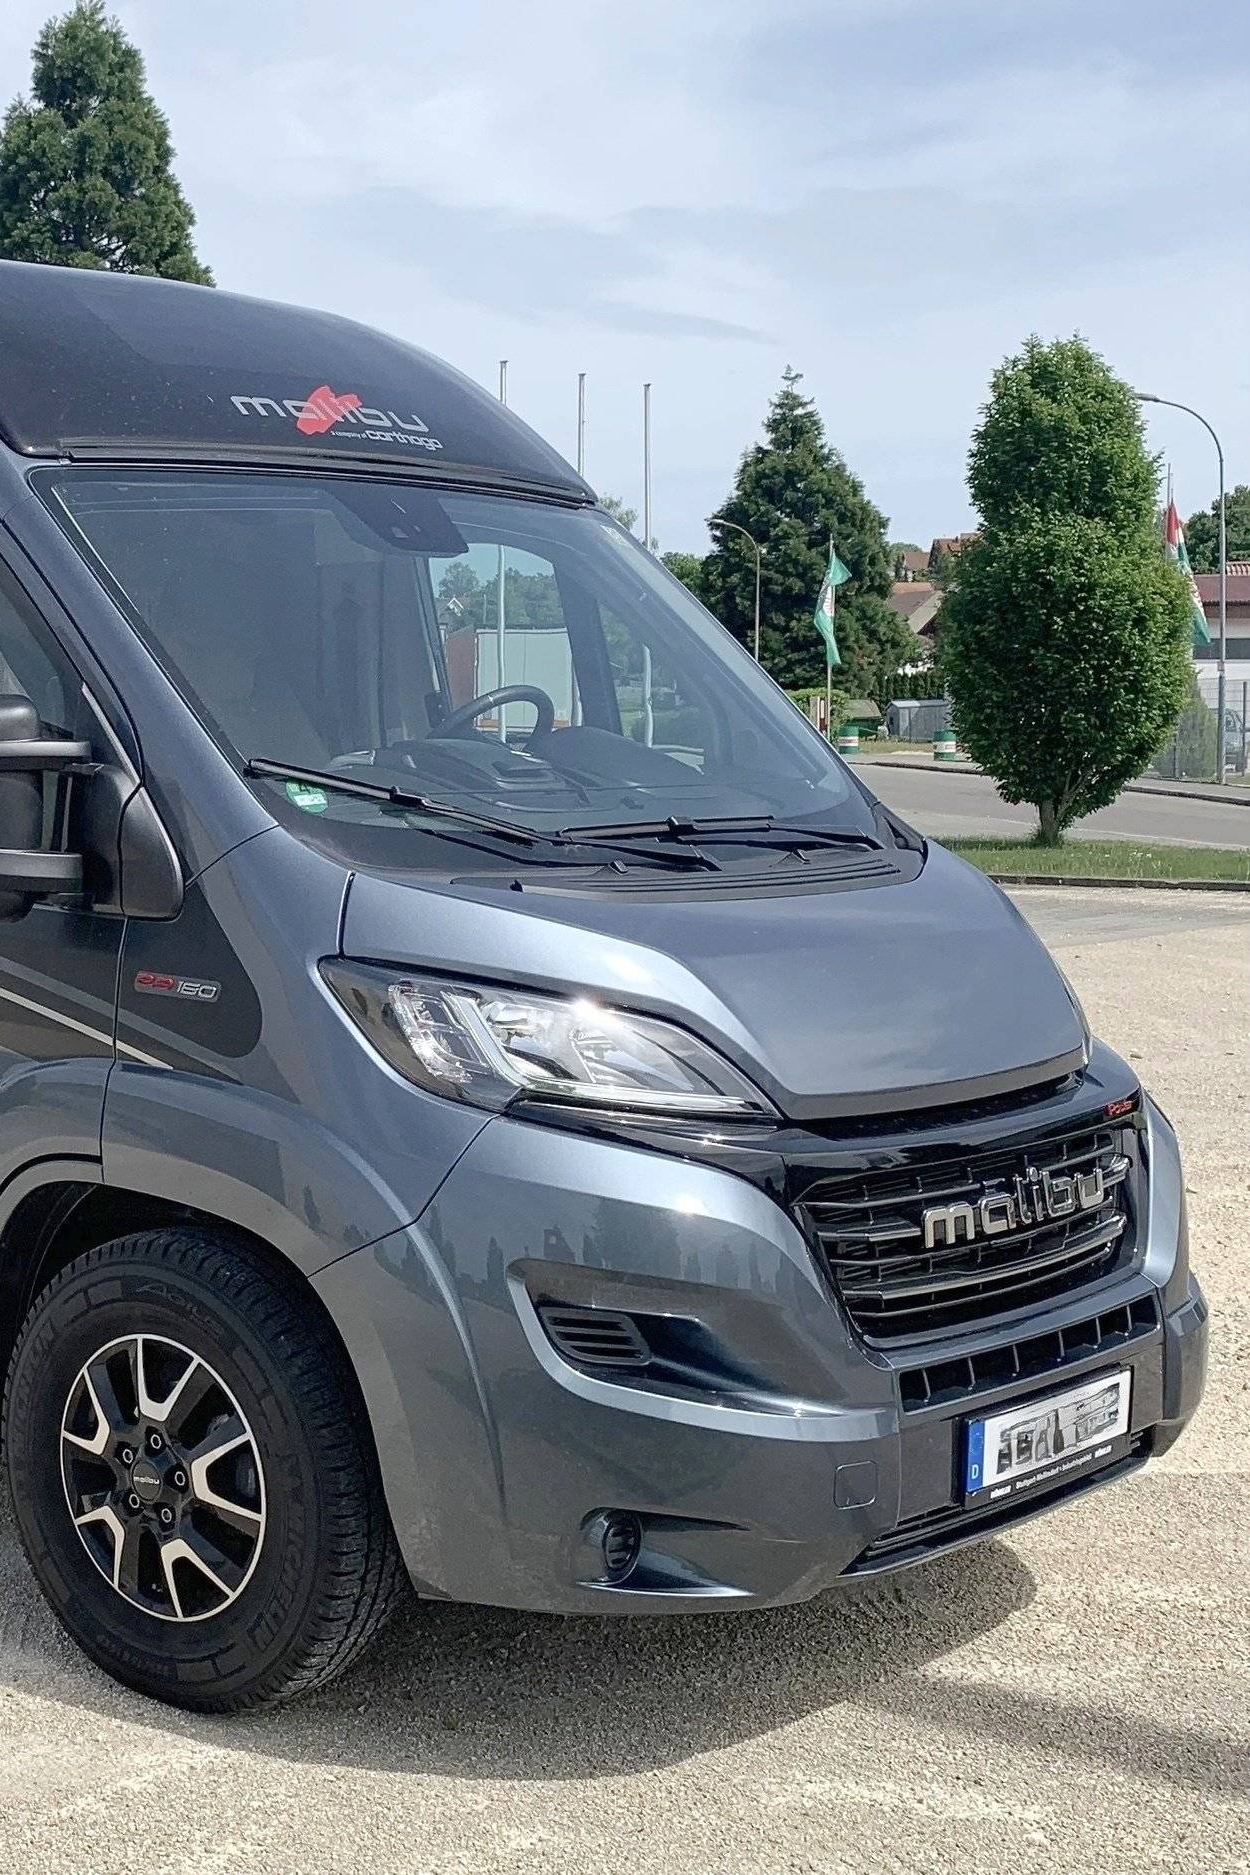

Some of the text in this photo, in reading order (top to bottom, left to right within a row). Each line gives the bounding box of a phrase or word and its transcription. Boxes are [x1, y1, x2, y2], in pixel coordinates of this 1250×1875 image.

[230, 395, 430, 432] malibu
[365, 430, 443, 450] carthago
[177, 981, 217, 998] 160
[922, 1166, 1105, 1248] malibu
[971, 1464, 979, 1480] D
